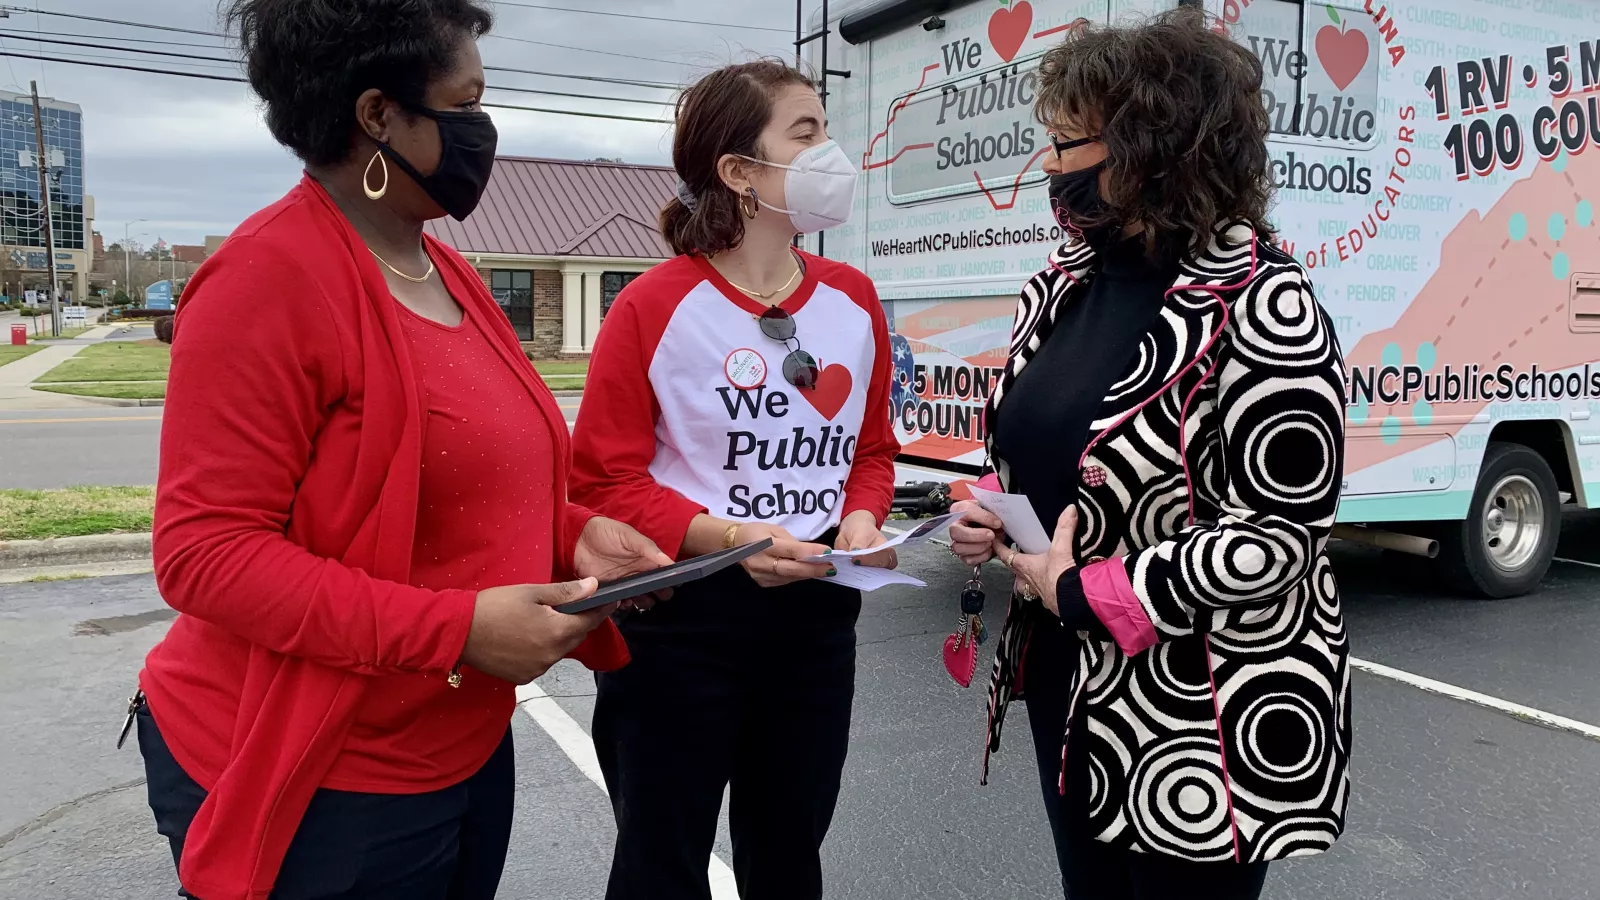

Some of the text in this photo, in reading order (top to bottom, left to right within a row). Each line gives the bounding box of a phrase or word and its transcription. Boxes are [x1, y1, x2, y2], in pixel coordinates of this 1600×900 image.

[1406, 9, 1488, 34] CUMBERLAND
[941, 37, 982, 76] We
[1248, 36, 1308, 80] We
[936, 64, 1037, 125] Public
[1424, 66, 1449, 121] 1
[1457, 55, 1512, 116] RV
[1546, 45, 1572, 98] 5
[936, 121, 1035, 170] Schools
[1443, 113, 1524, 181] 100
[1268, 151, 1372, 196] chools
[872, 223, 1065, 257] WeHeartNCPublicSchools.or
[1306, 243, 1327, 269] of
[961, 260, 1006, 277] HANOVER
[1367, 254, 1418, 272] ORANGE
[1346, 284, 1397, 302] PENDER
[913, 364, 929, 397] 5
[715, 384, 789, 421] We
[901, 400, 985, 443] COUNT
[722, 424, 856, 472] Public
